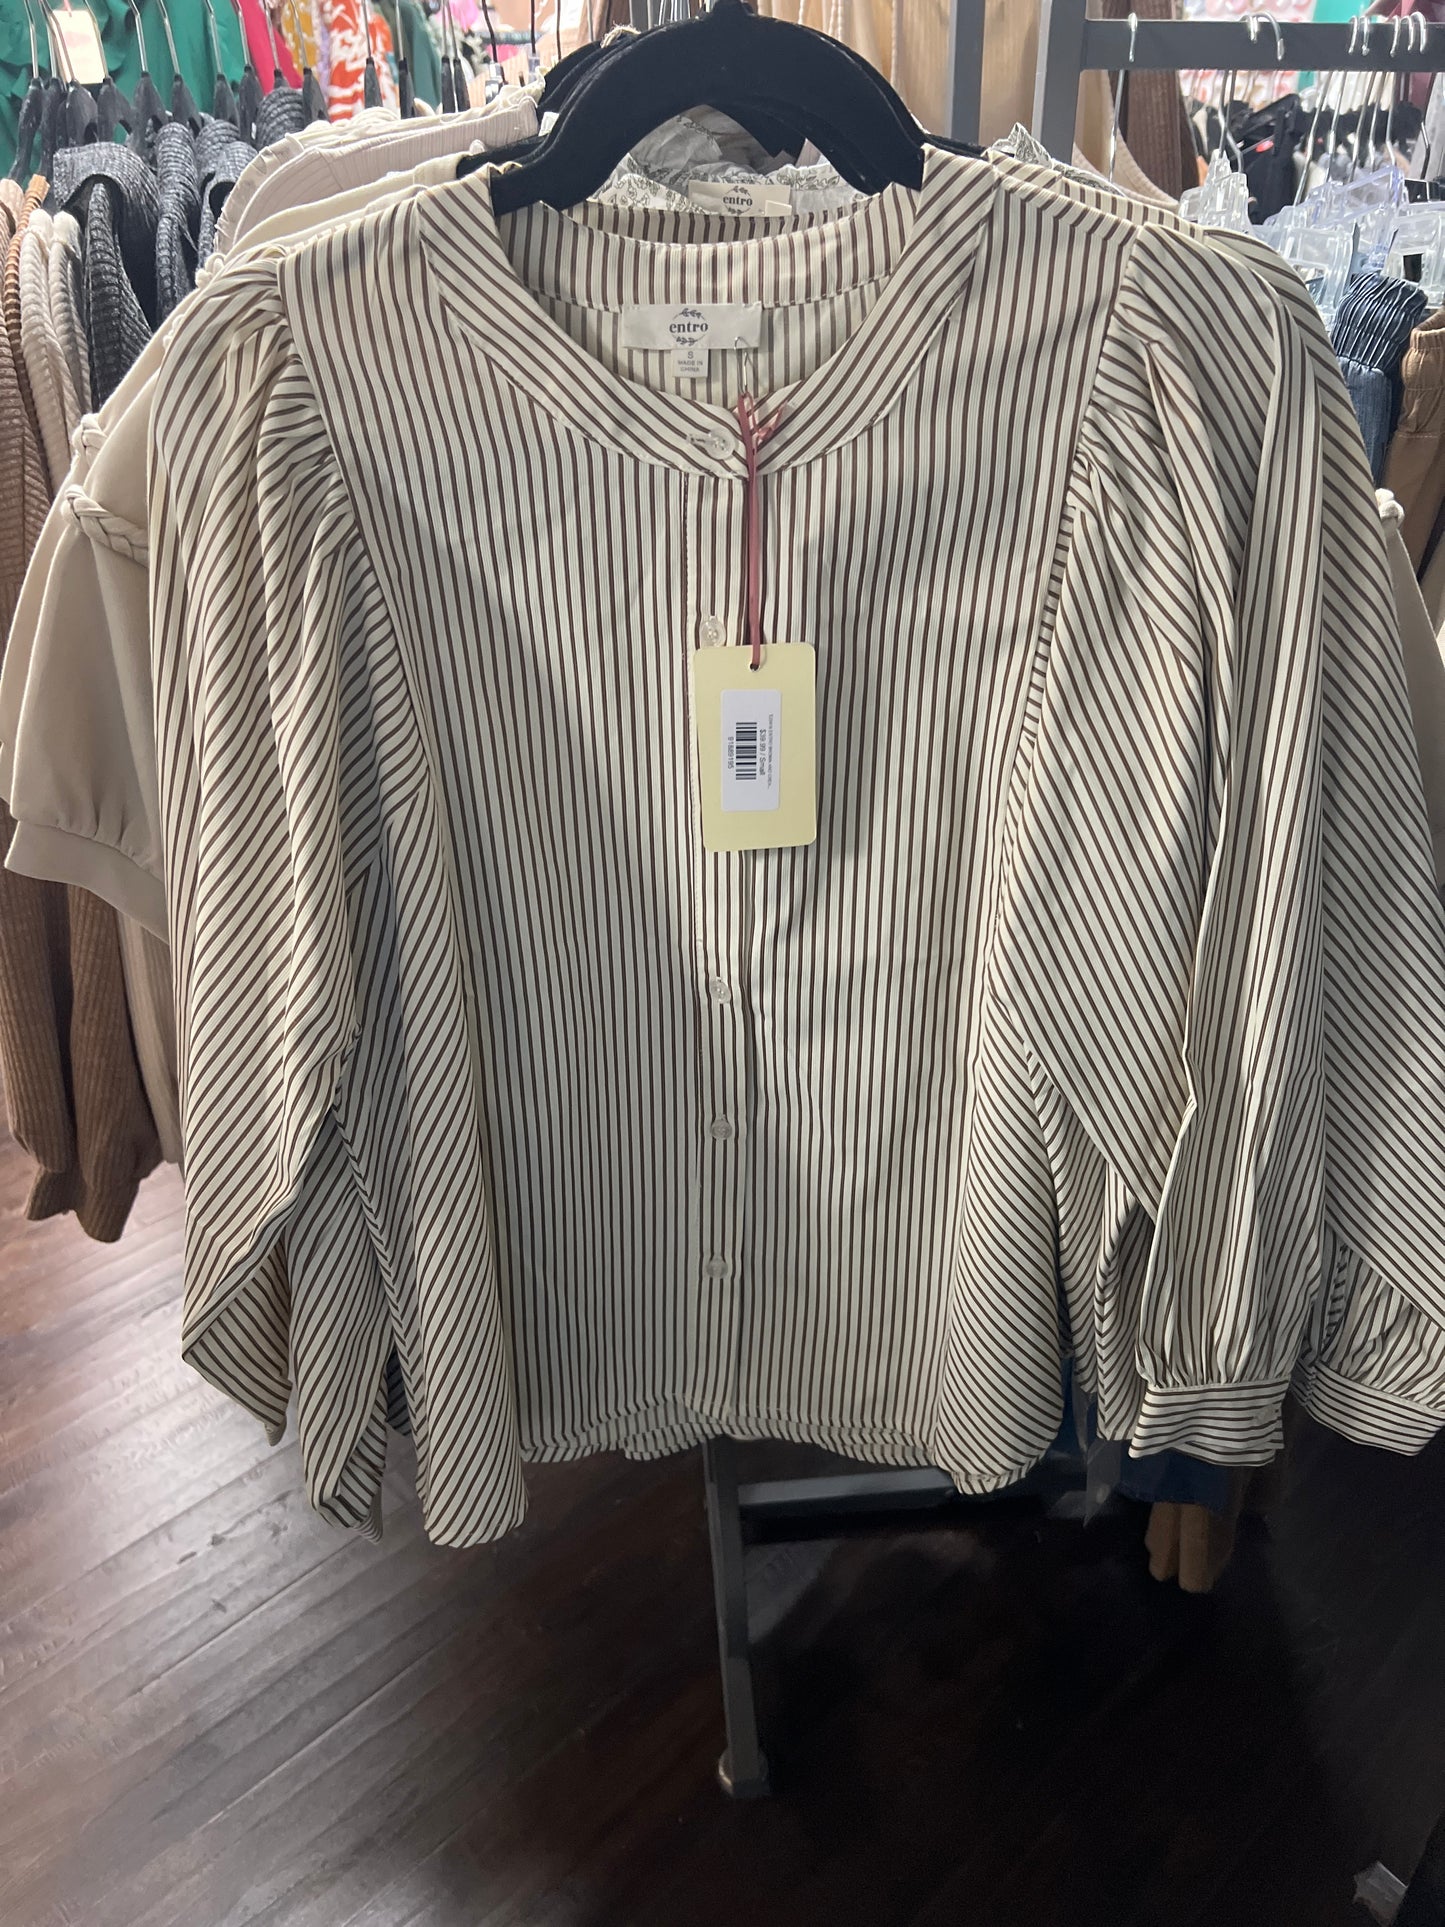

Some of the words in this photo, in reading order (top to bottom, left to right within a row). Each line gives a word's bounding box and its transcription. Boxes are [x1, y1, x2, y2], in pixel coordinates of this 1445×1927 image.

[722, 195, 753, 207] entro
[669, 321, 709, 333] entro
[687, 351, 694, 360] S
